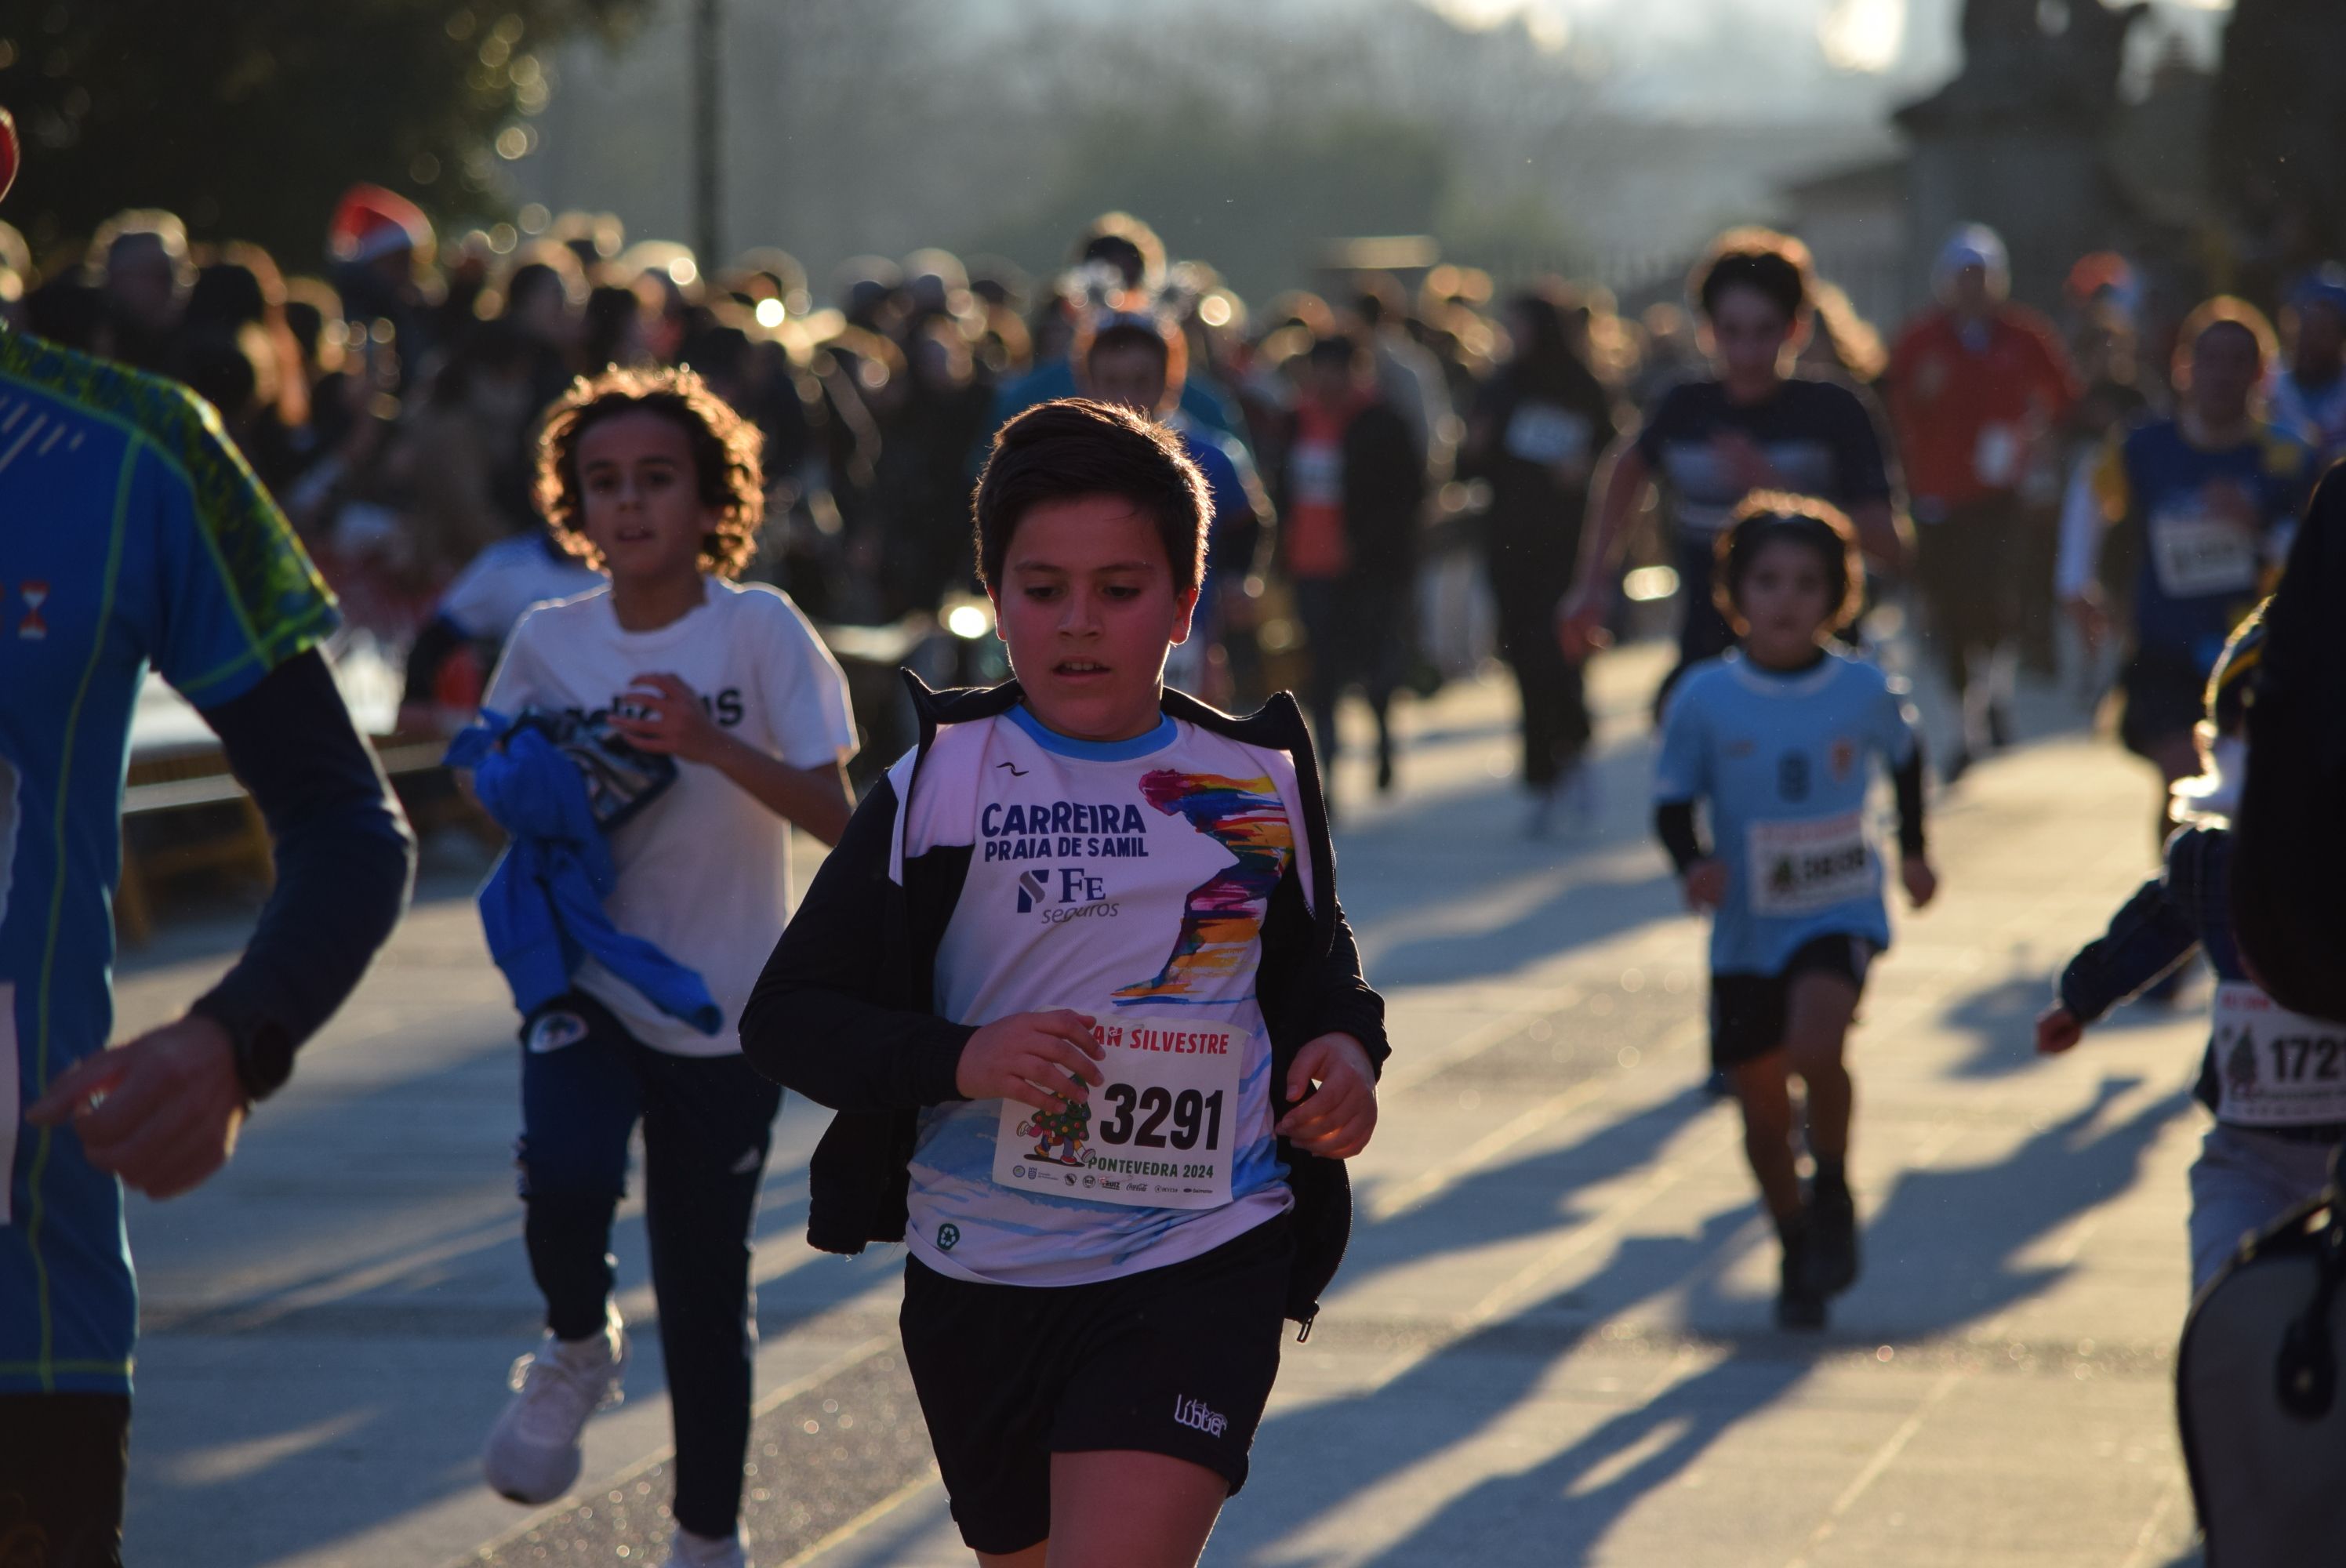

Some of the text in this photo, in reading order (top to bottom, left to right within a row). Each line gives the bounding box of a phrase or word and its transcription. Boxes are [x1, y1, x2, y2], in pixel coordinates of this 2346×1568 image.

[981, 800, 1146, 837] CARREIRA
[984, 837, 1149, 862] PRAIA DE SAMIL
[1041, 902, 1120, 924] seguros
[1093, 1025, 1229, 1054] AN SILVESTRE
[2271, 1035, 2346, 1082] 172
[1099, 1083, 1224, 1151] 3291
[1088, 1156, 1214, 1179] PONTEVEDRA 2024
